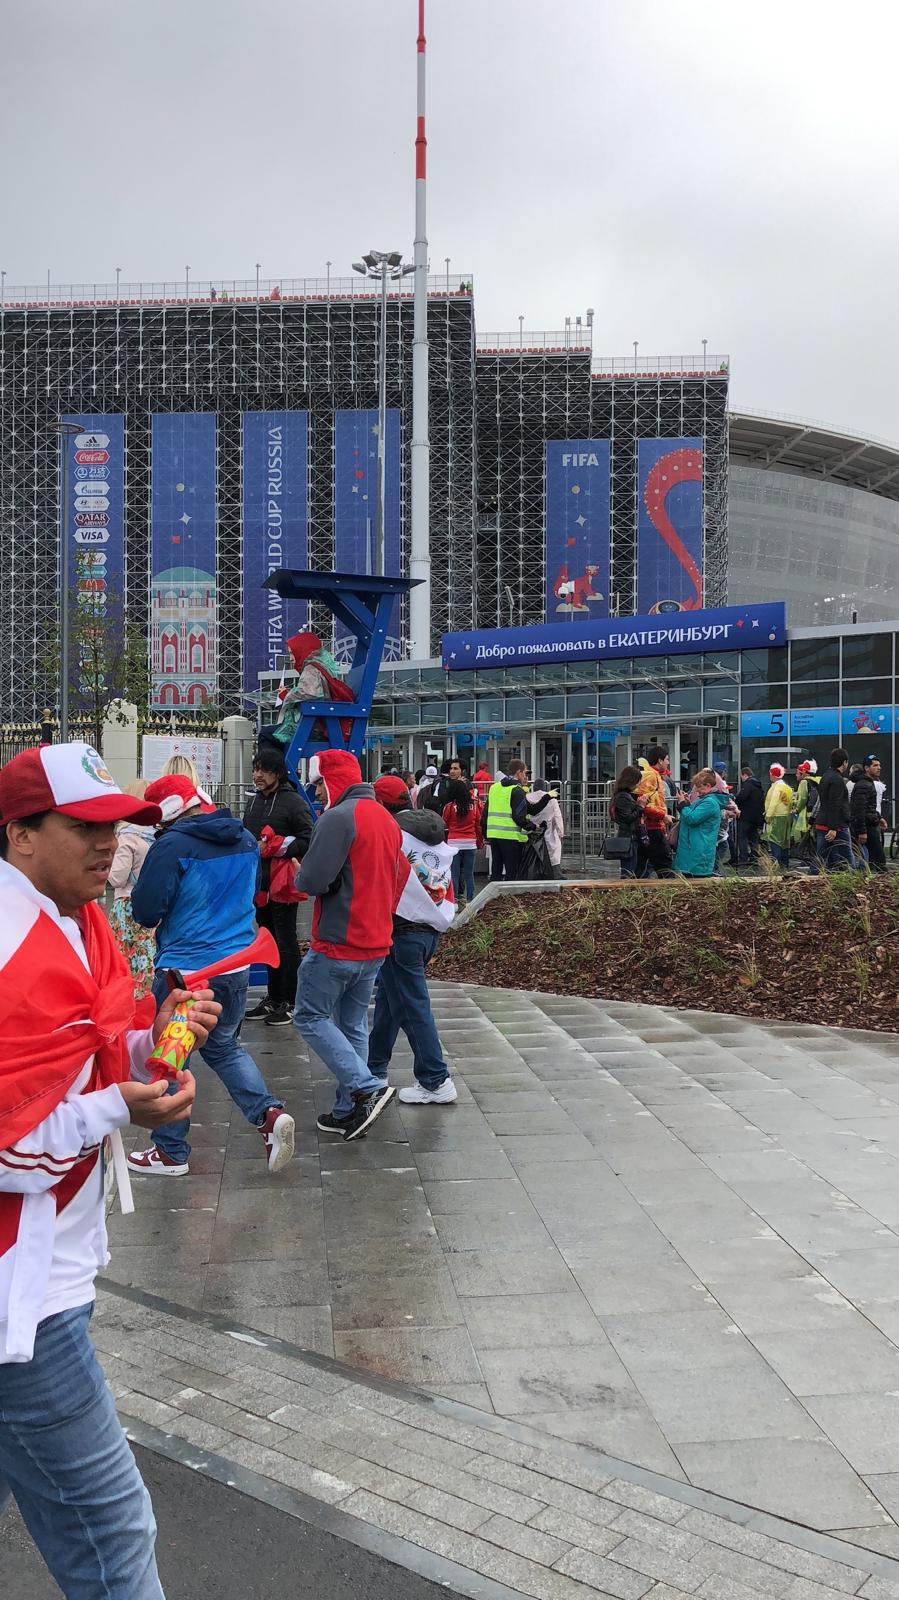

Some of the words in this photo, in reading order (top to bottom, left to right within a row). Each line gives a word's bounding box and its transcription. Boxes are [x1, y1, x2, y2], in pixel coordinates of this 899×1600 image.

[268, 425, 283, 495] RUSSIA
[562, 453, 599, 467] FIFA
[77, 513, 106, 522] QATAR
[268, 499, 282, 541] CUP
[80, 531, 104, 540] VISA
[268, 614, 283, 653] FIFA
[475, 643, 515, 660] Добро
[518, 639, 595, 656] пожаловать
[598, 638, 606, 649] в
[609, 623, 733, 648] ЕКАТЕРИНБУРГ
[769, 713, 785, 734] 5
